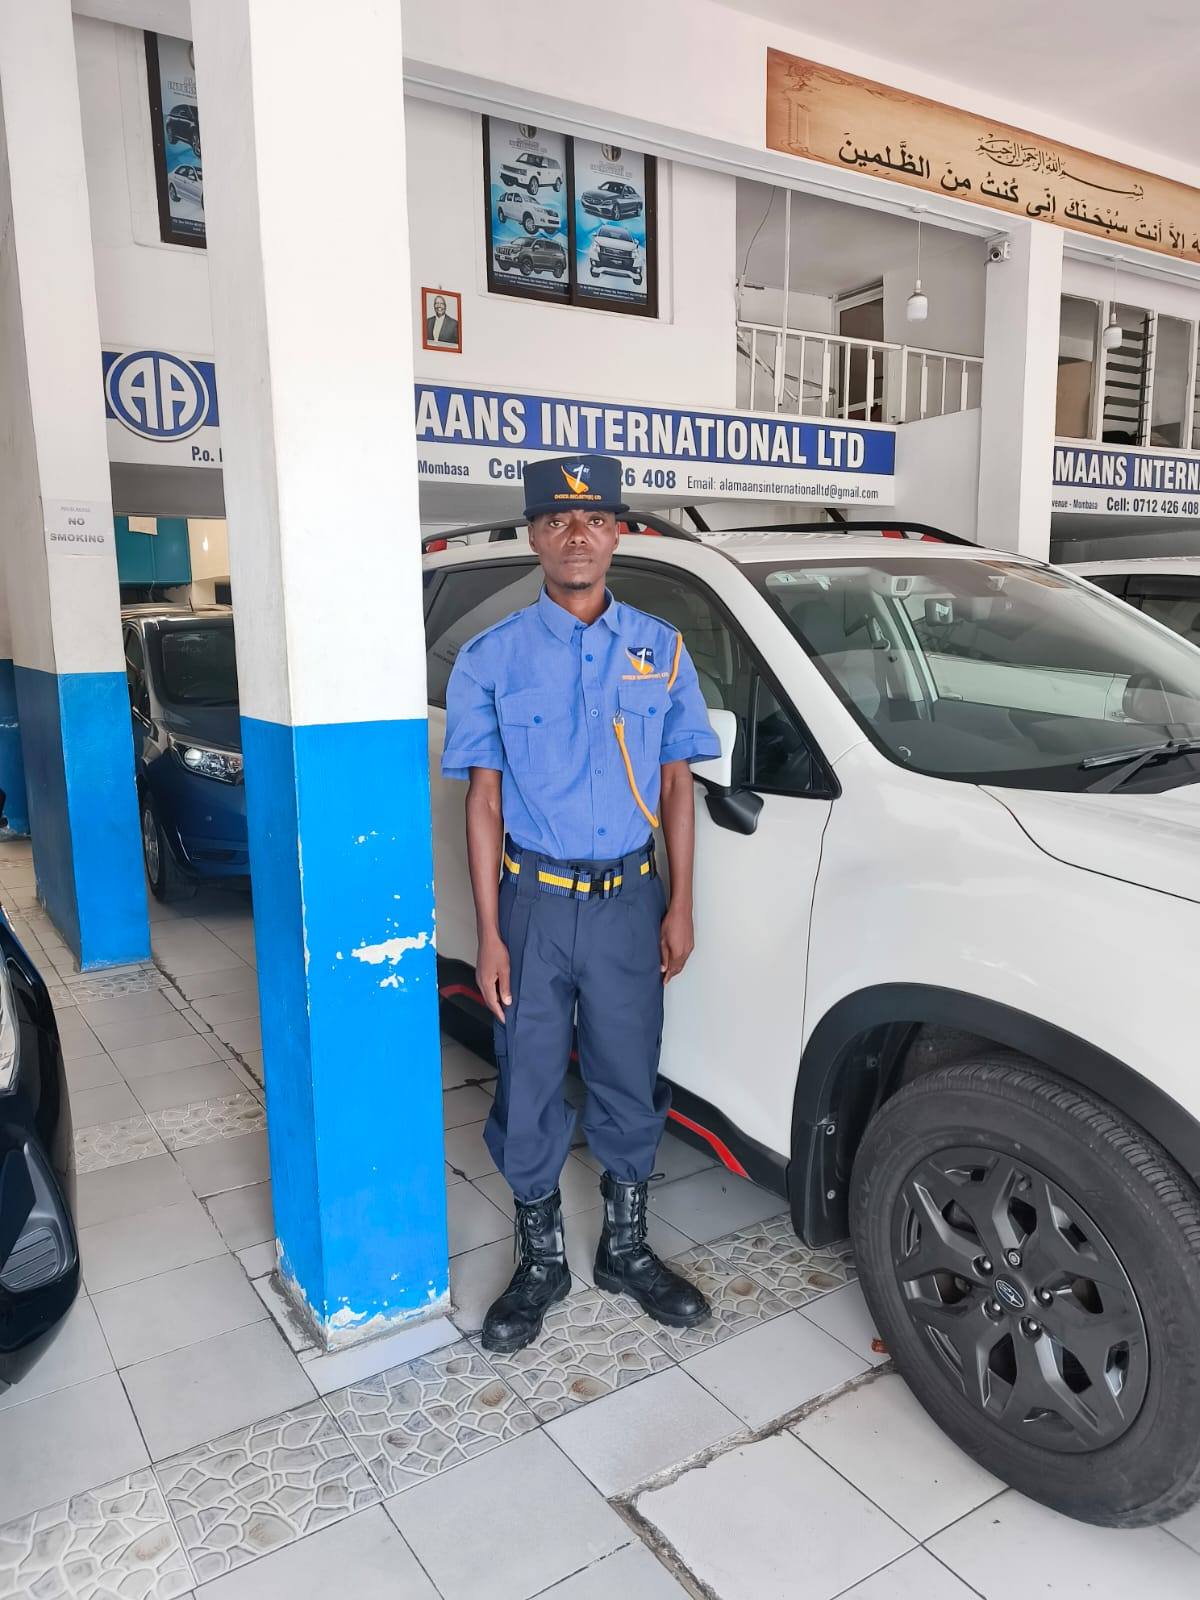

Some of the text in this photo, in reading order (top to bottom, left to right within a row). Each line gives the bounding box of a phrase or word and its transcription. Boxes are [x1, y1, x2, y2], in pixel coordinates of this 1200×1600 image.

[541, 402, 807, 464] INTERNATIONAL
[817, 429, 865, 469] LTD
[418, 460, 469, 476] Mombasa
[643, 469, 676, 489] 408
[687, 474, 717, 491] Email:
[719, 478, 879, 499] alamaansinternationalltd@gmail.com
[1107, 497, 1130, 511] Cell:
[1133, 499, 1158, 513] 0712
[1161, 501, 1179, 514] 426
[1182, 502, 1199, 515] 408
[68, 517, 85, 526] NO
[50, 533, 105, 544] SMOKING
